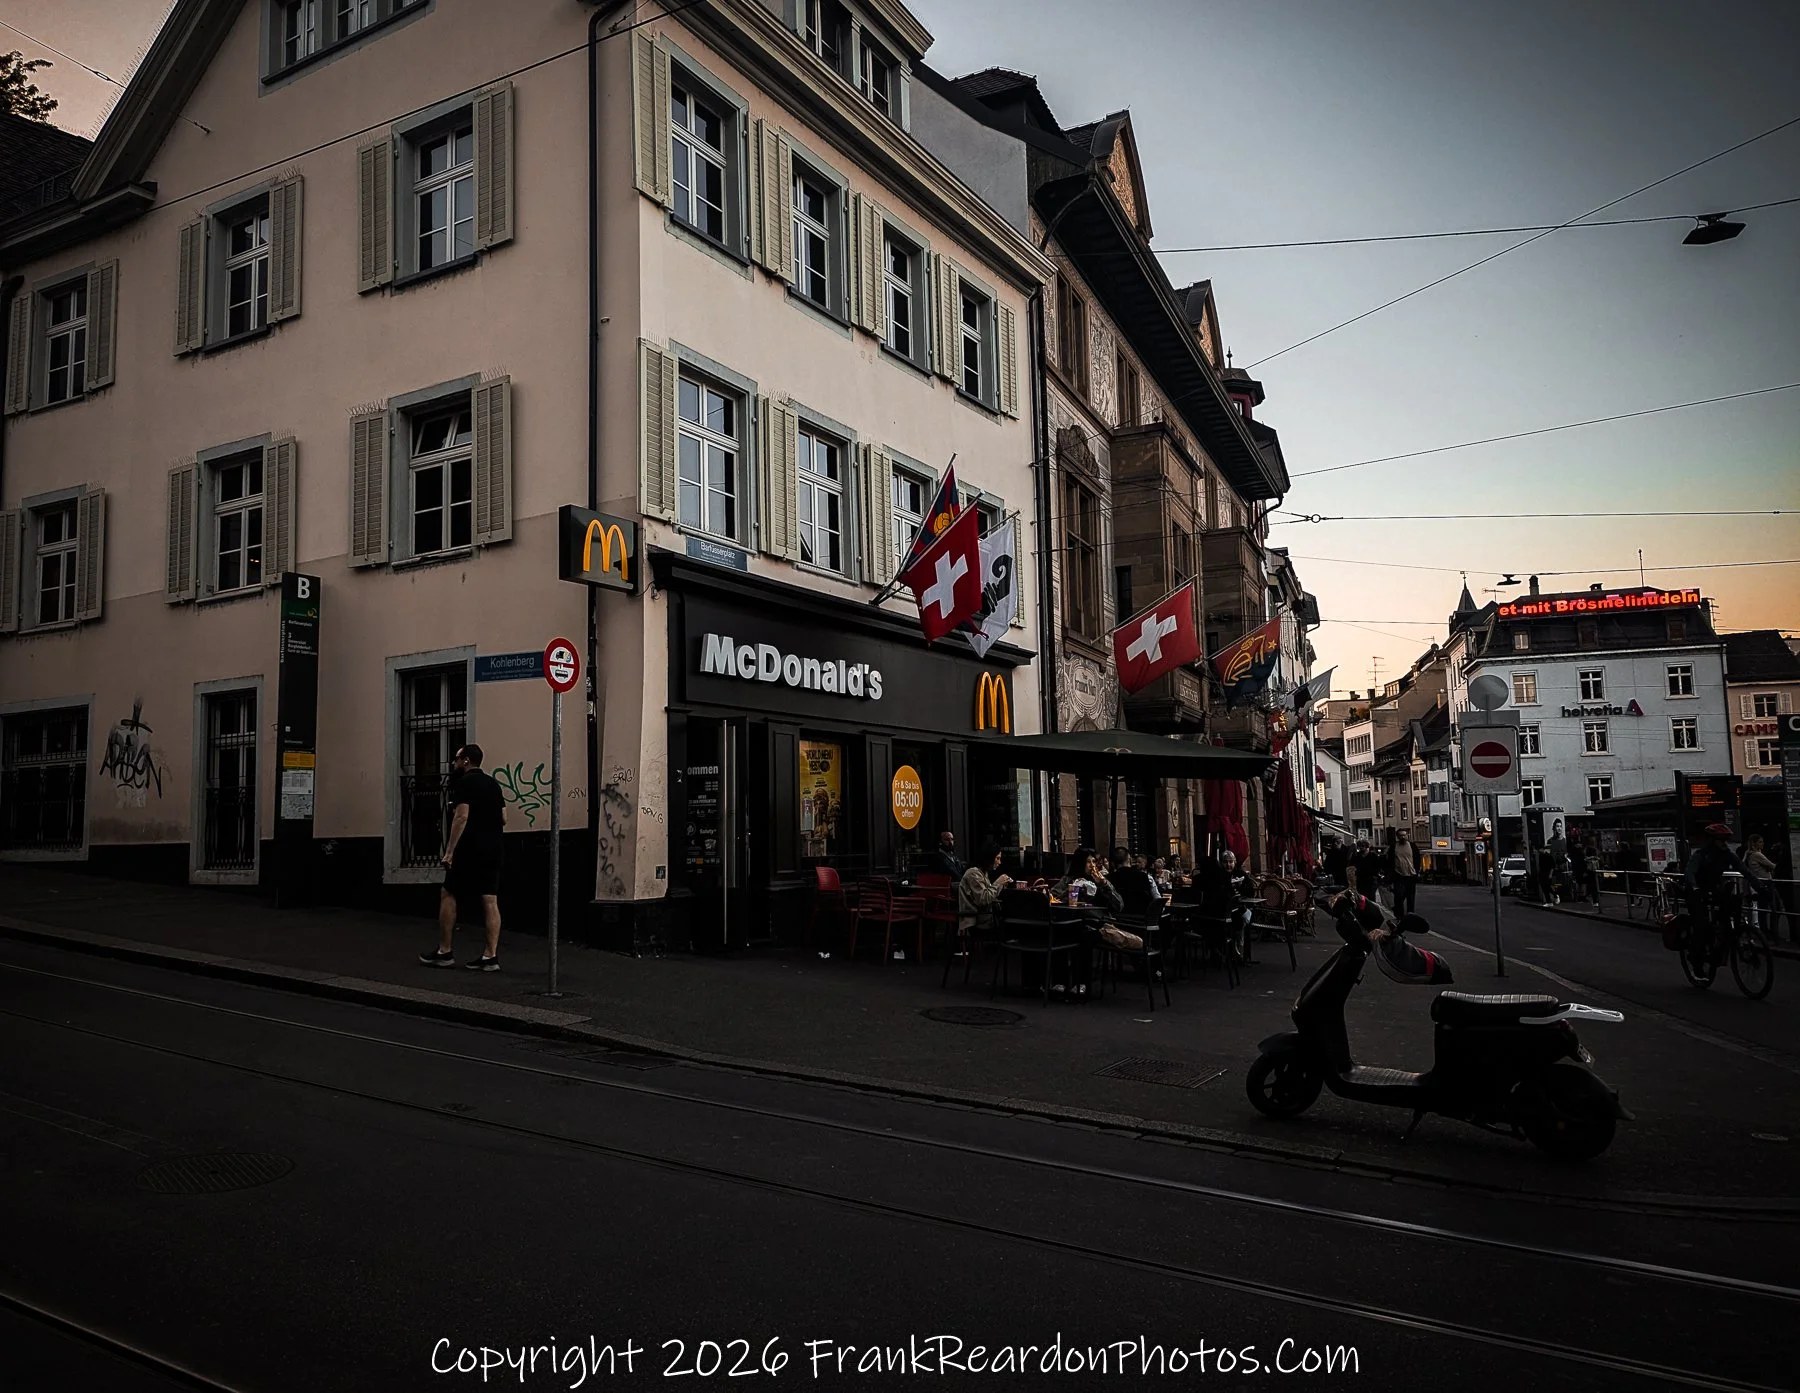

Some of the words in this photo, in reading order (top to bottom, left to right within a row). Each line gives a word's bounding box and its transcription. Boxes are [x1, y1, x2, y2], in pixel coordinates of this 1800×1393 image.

[700, 541, 736, 559] Barfüsserplatz
[297, 576, 311, 600] B
[1522, 600, 1551, 615] mit
[1556, 591, 1699, 612] Brösmelinudeln
[490, 656, 535, 669] Kohlenberg
[699, 631, 884, 702] McDonald's
[1561, 703, 1623, 718] helvetia
[895, 791, 920, 808] 05:00
[901, 809, 915, 818] offen
